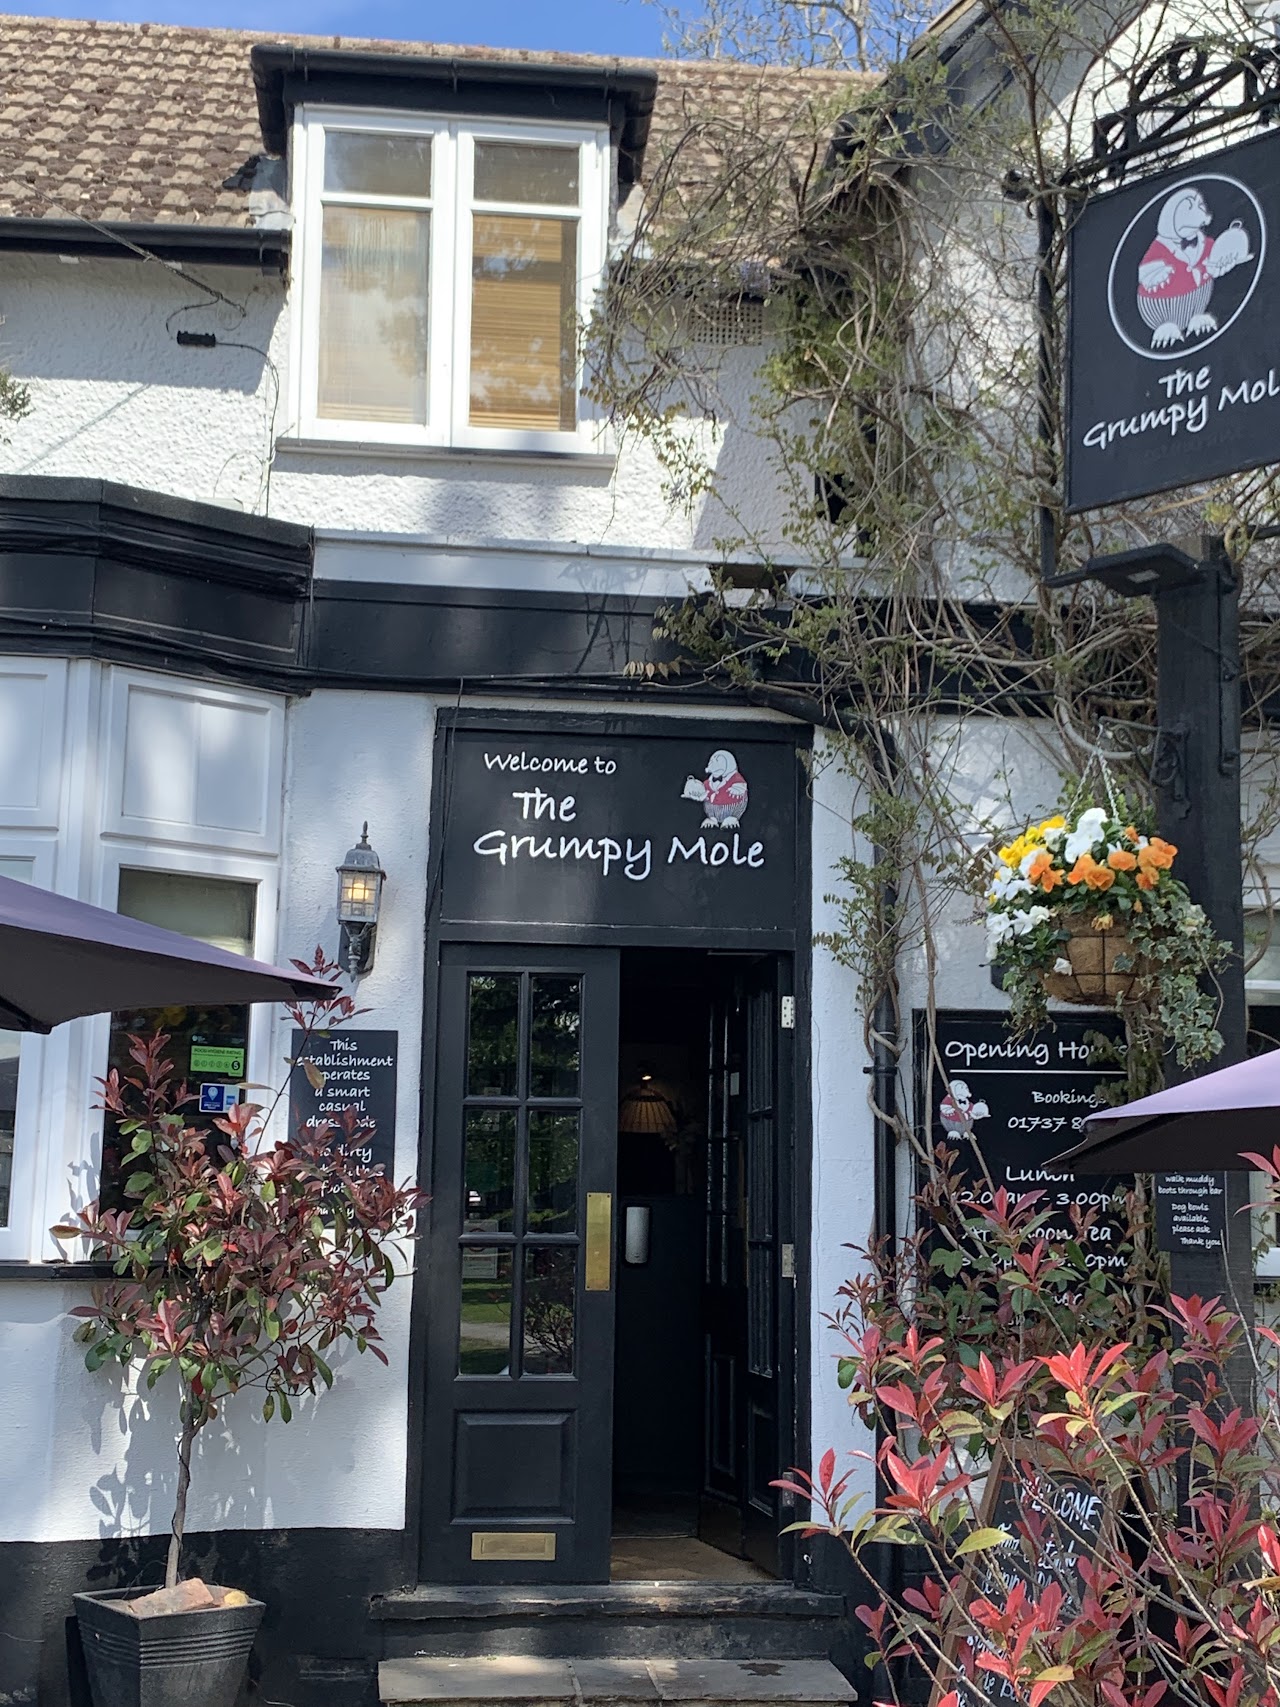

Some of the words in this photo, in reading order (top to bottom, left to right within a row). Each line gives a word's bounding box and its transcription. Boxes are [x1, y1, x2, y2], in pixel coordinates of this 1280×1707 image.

[1159, 365, 1211, 398] The
[1083, 394, 1209, 450] Grumpy
[1218, 368, 1280, 411] Mol
[484, 752, 588, 774] Welcome
[594, 755, 617, 774] to
[512, 787, 576, 822] The
[473, 830, 650, 880] Grumpy
[667, 833, 765, 867] Mole
[329, 1037, 358, 1051] This
[296, 1053, 394, 1067] etablishment
[944, 1041, 1049, 1065] Opening
[1058, 1041, 1128, 1060] Hos
[322, 1069, 370, 1081] perates
[327, 1086, 371, 1097] smart
[1008, 1117, 1067, 1132] 01737
[1071, 1117, 1083, 1130] 8
[1186, 1174, 1215, 1186] muddy
[1158, 1186, 1177, 1194] boots
[1178, 1187, 1208, 1197] through
[1209, 1186, 1223, 1194] bar
[1171, 1203, 1186, 1213] Dog
[1188, 1202, 1209, 1211] bowls
[1173, 1213, 1209, 1223] available
[1171, 1224, 1195, 1235] please
[1196, 1225, 1211, 1233] ask
[1180, 1237, 1204, 1245] Thank
[1205, 1239, 1221, 1249] you
